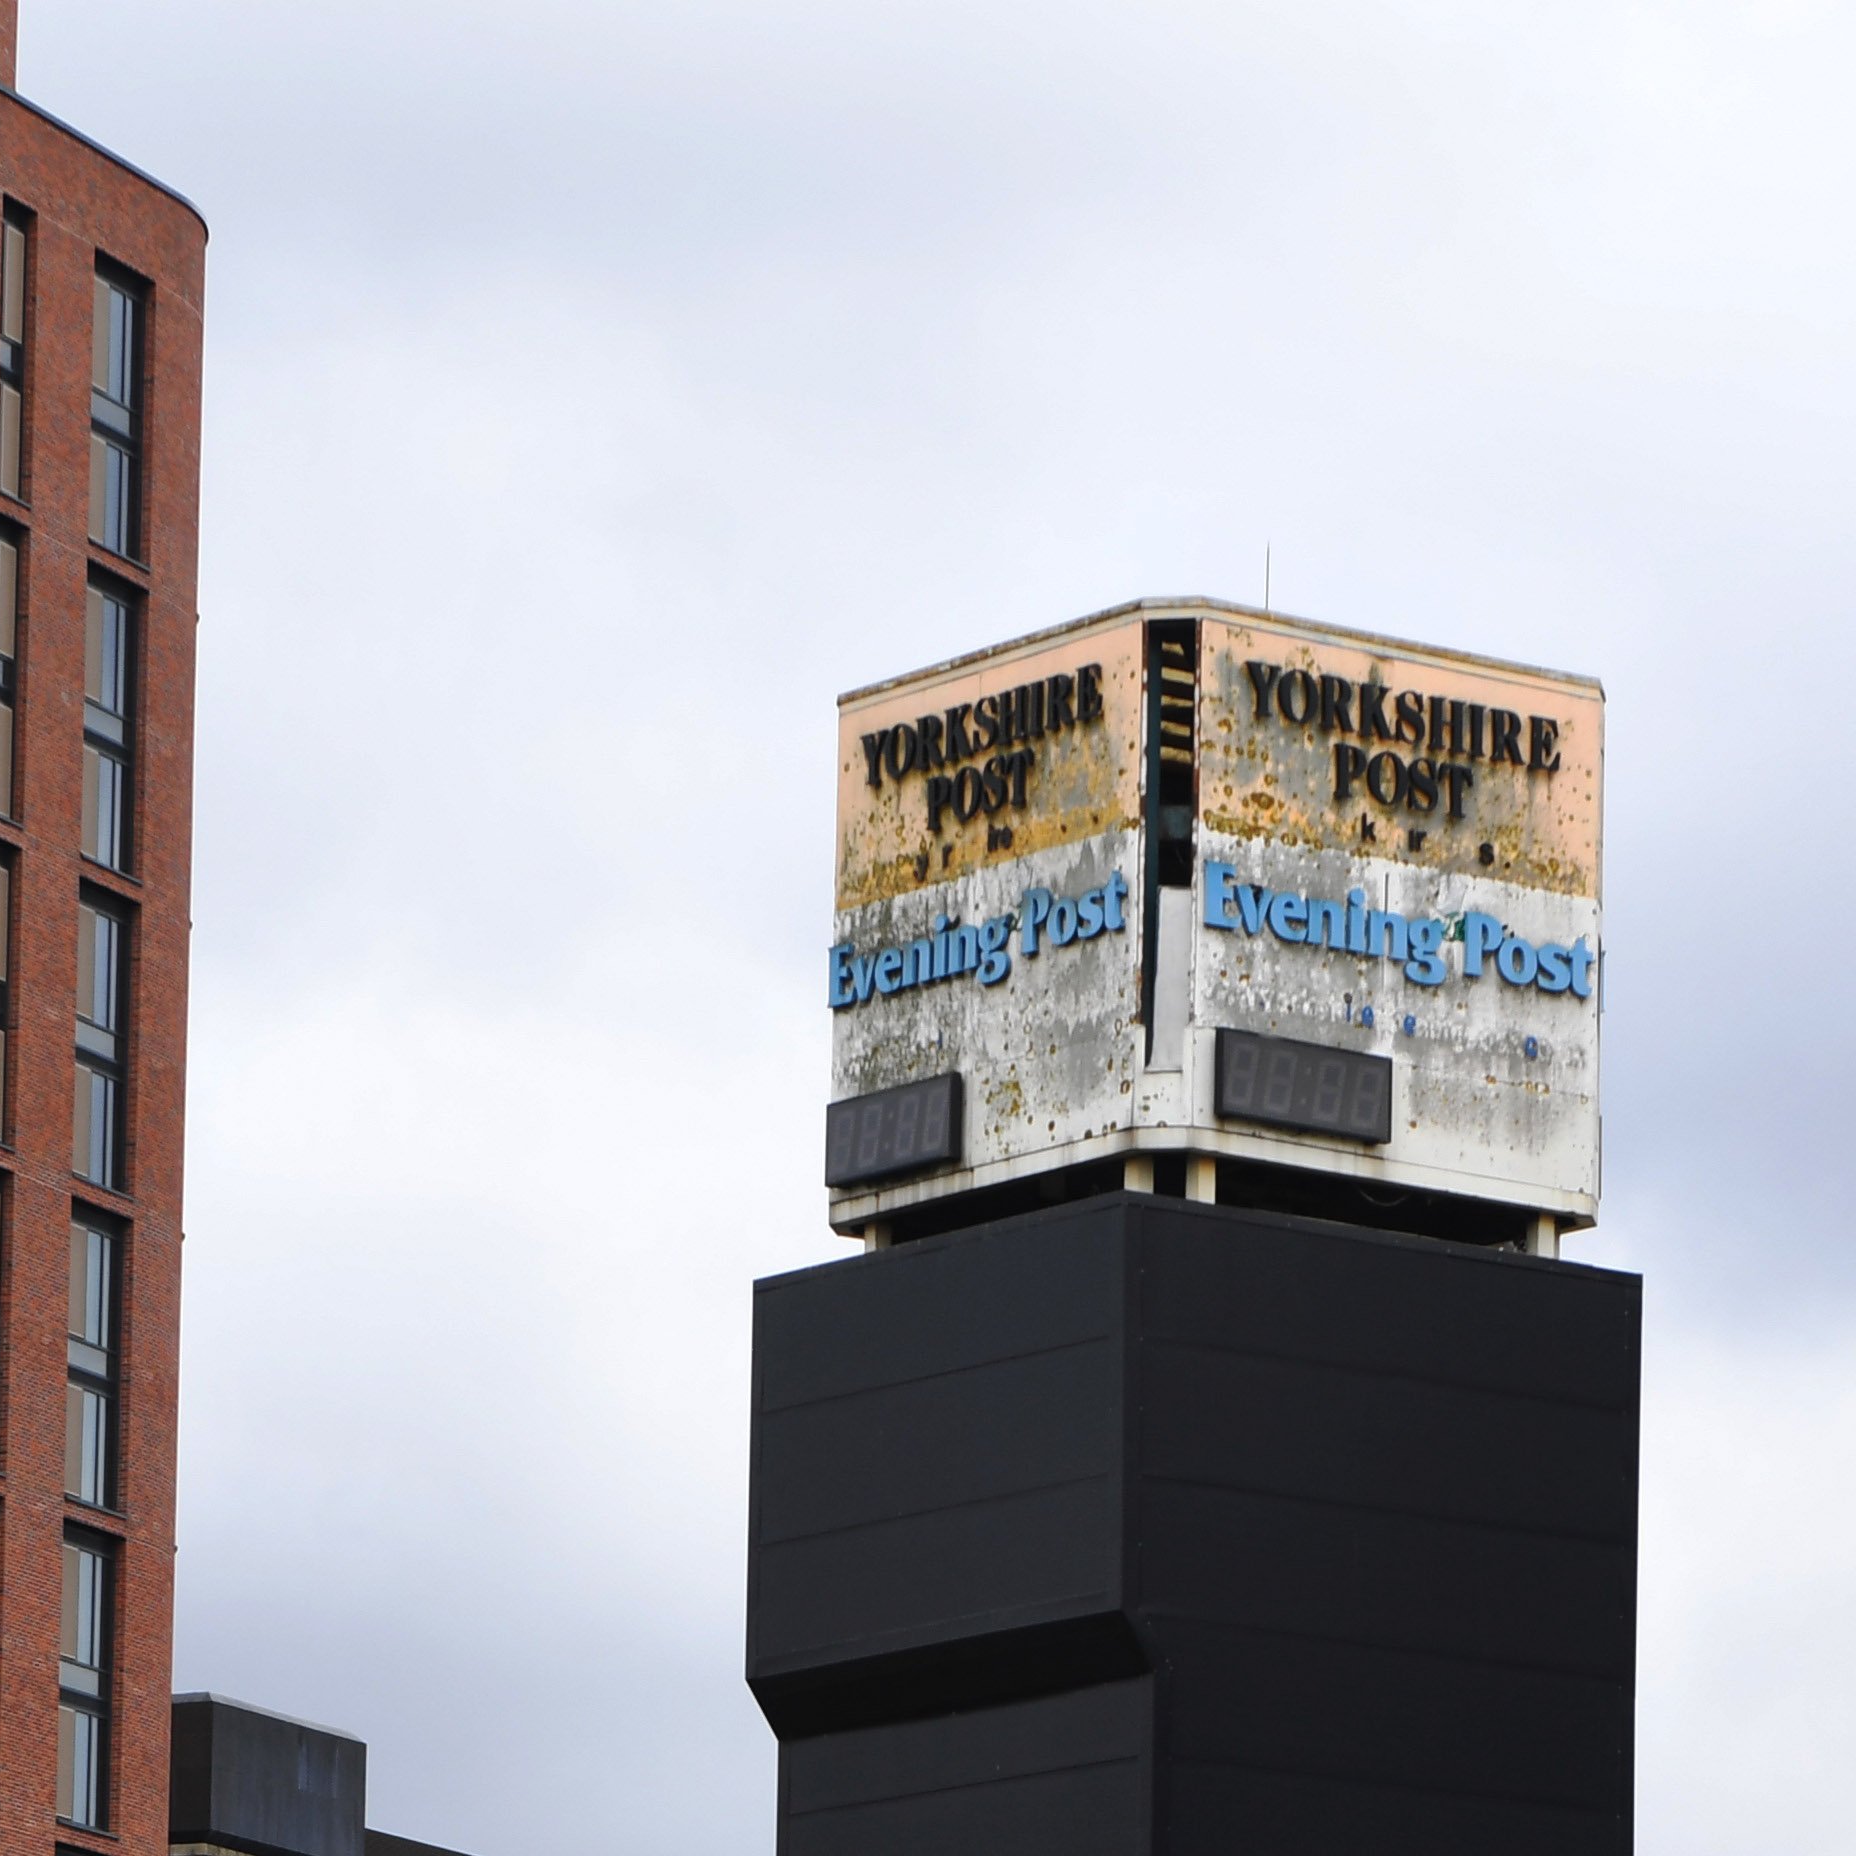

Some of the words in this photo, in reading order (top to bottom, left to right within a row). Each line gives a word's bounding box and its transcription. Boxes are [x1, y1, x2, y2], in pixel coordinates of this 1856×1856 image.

[859, 663, 1104, 789] YORKSHIRE
[1245, 661, 1561, 773] YORKSHIRE
[926, 748, 1036, 834] POST
[1333, 742, 1474, 819] POST
[829, 912, 1013, 1009] Evening
[1020, 870, 1129, 956] Post
[1203, 860, 1448, 987] Evening
[1463, 911, 1594, 999] Post
